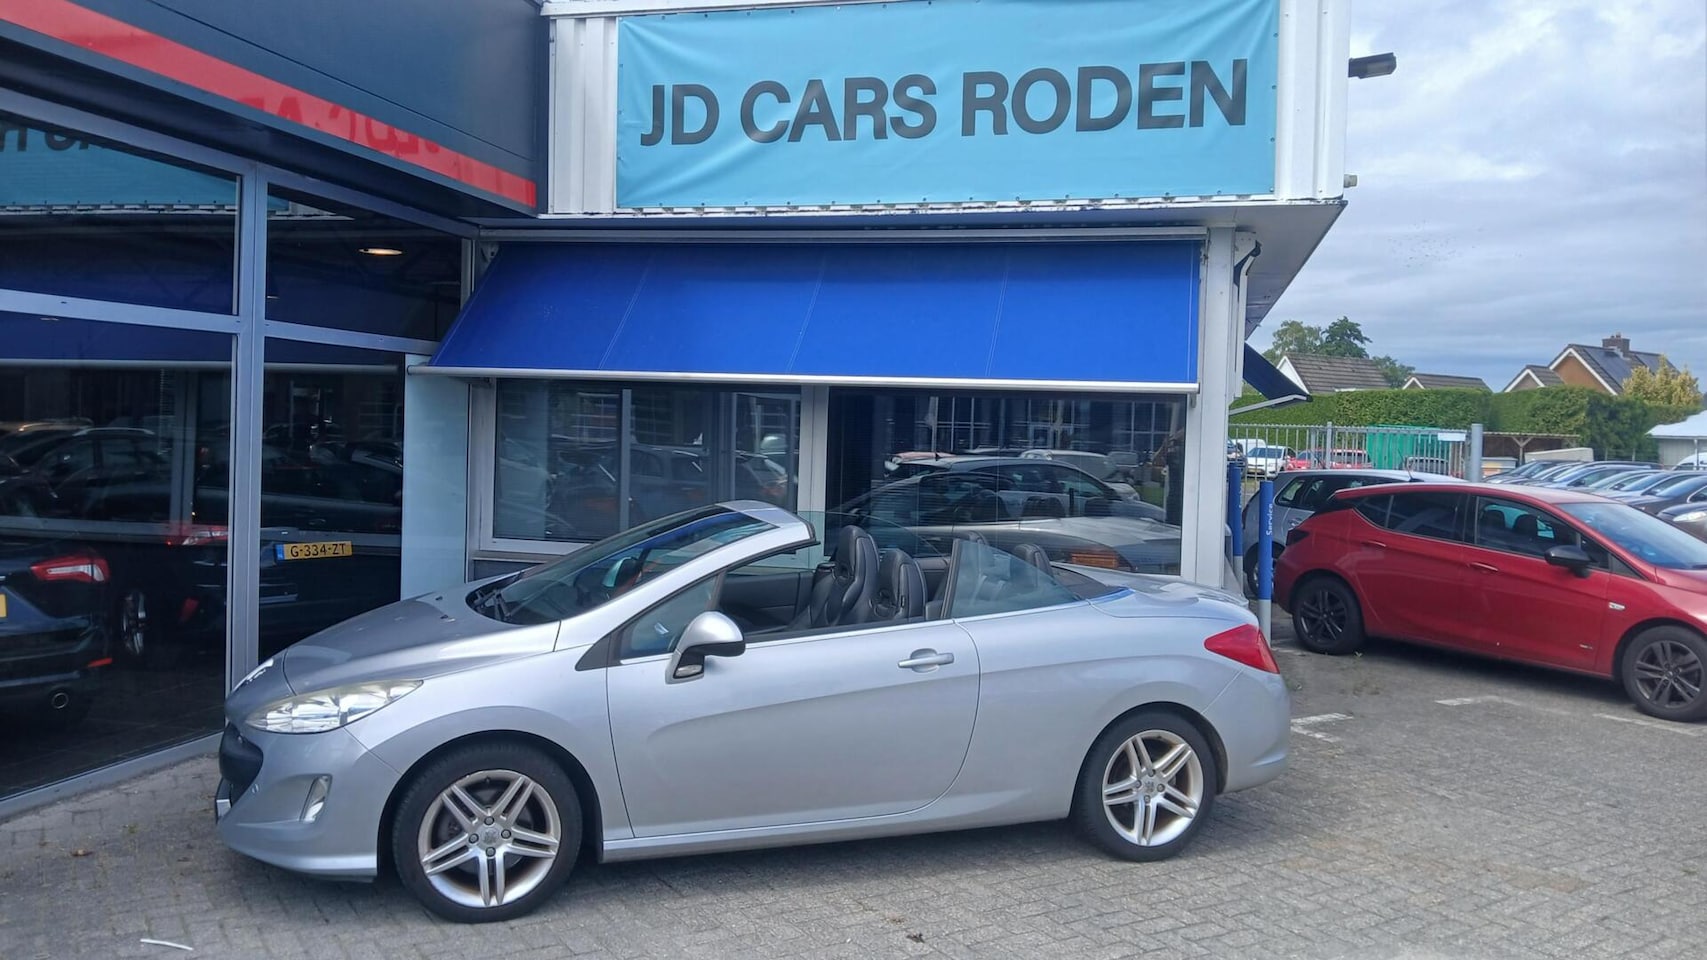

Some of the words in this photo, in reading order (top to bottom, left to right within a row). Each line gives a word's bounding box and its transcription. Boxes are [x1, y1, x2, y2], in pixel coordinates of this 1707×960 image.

[641, 84, 720, 146] JD
[740, 74, 937, 143] CARS
[961, 58, 1248, 137] RODEN
[1265, 503, 1273, 535] Service
[290, 544, 346, 558] G-334-ZT
